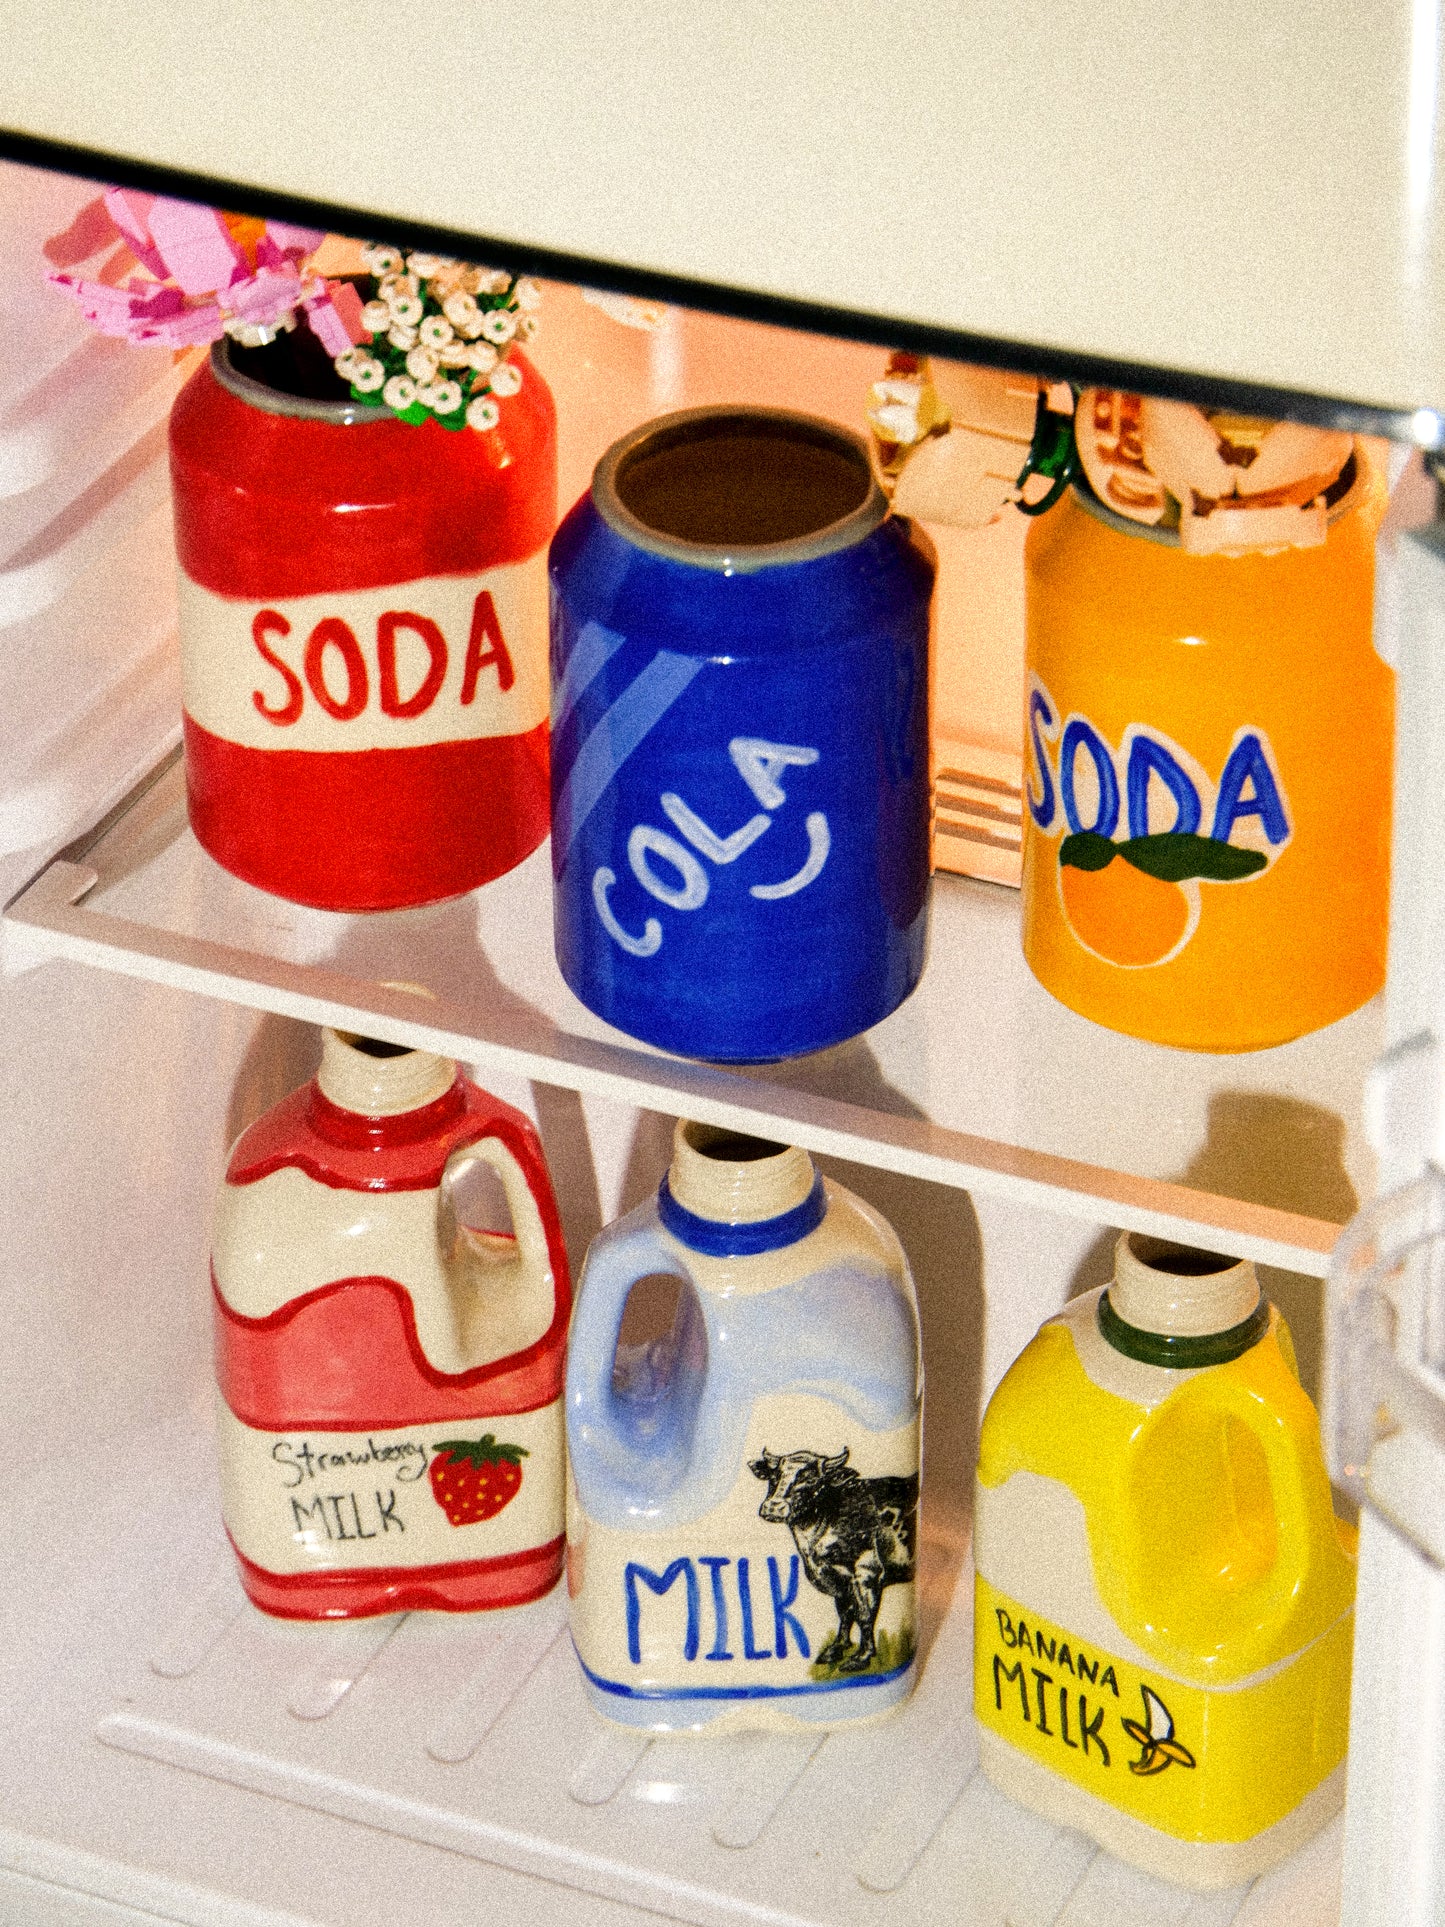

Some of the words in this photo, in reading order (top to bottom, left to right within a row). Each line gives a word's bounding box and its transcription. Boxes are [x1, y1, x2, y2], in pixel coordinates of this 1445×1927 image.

[251, 590, 515, 727] SODA
[1026, 684, 1292, 847] SODA
[592, 736, 820, 958] COLA
[290, 1489, 406, 1544] MILK
[624, 1554, 811, 1665] MILK
[995, 1608, 1120, 1698] BANANA
[992, 1653, 1111, 1768] MILK
